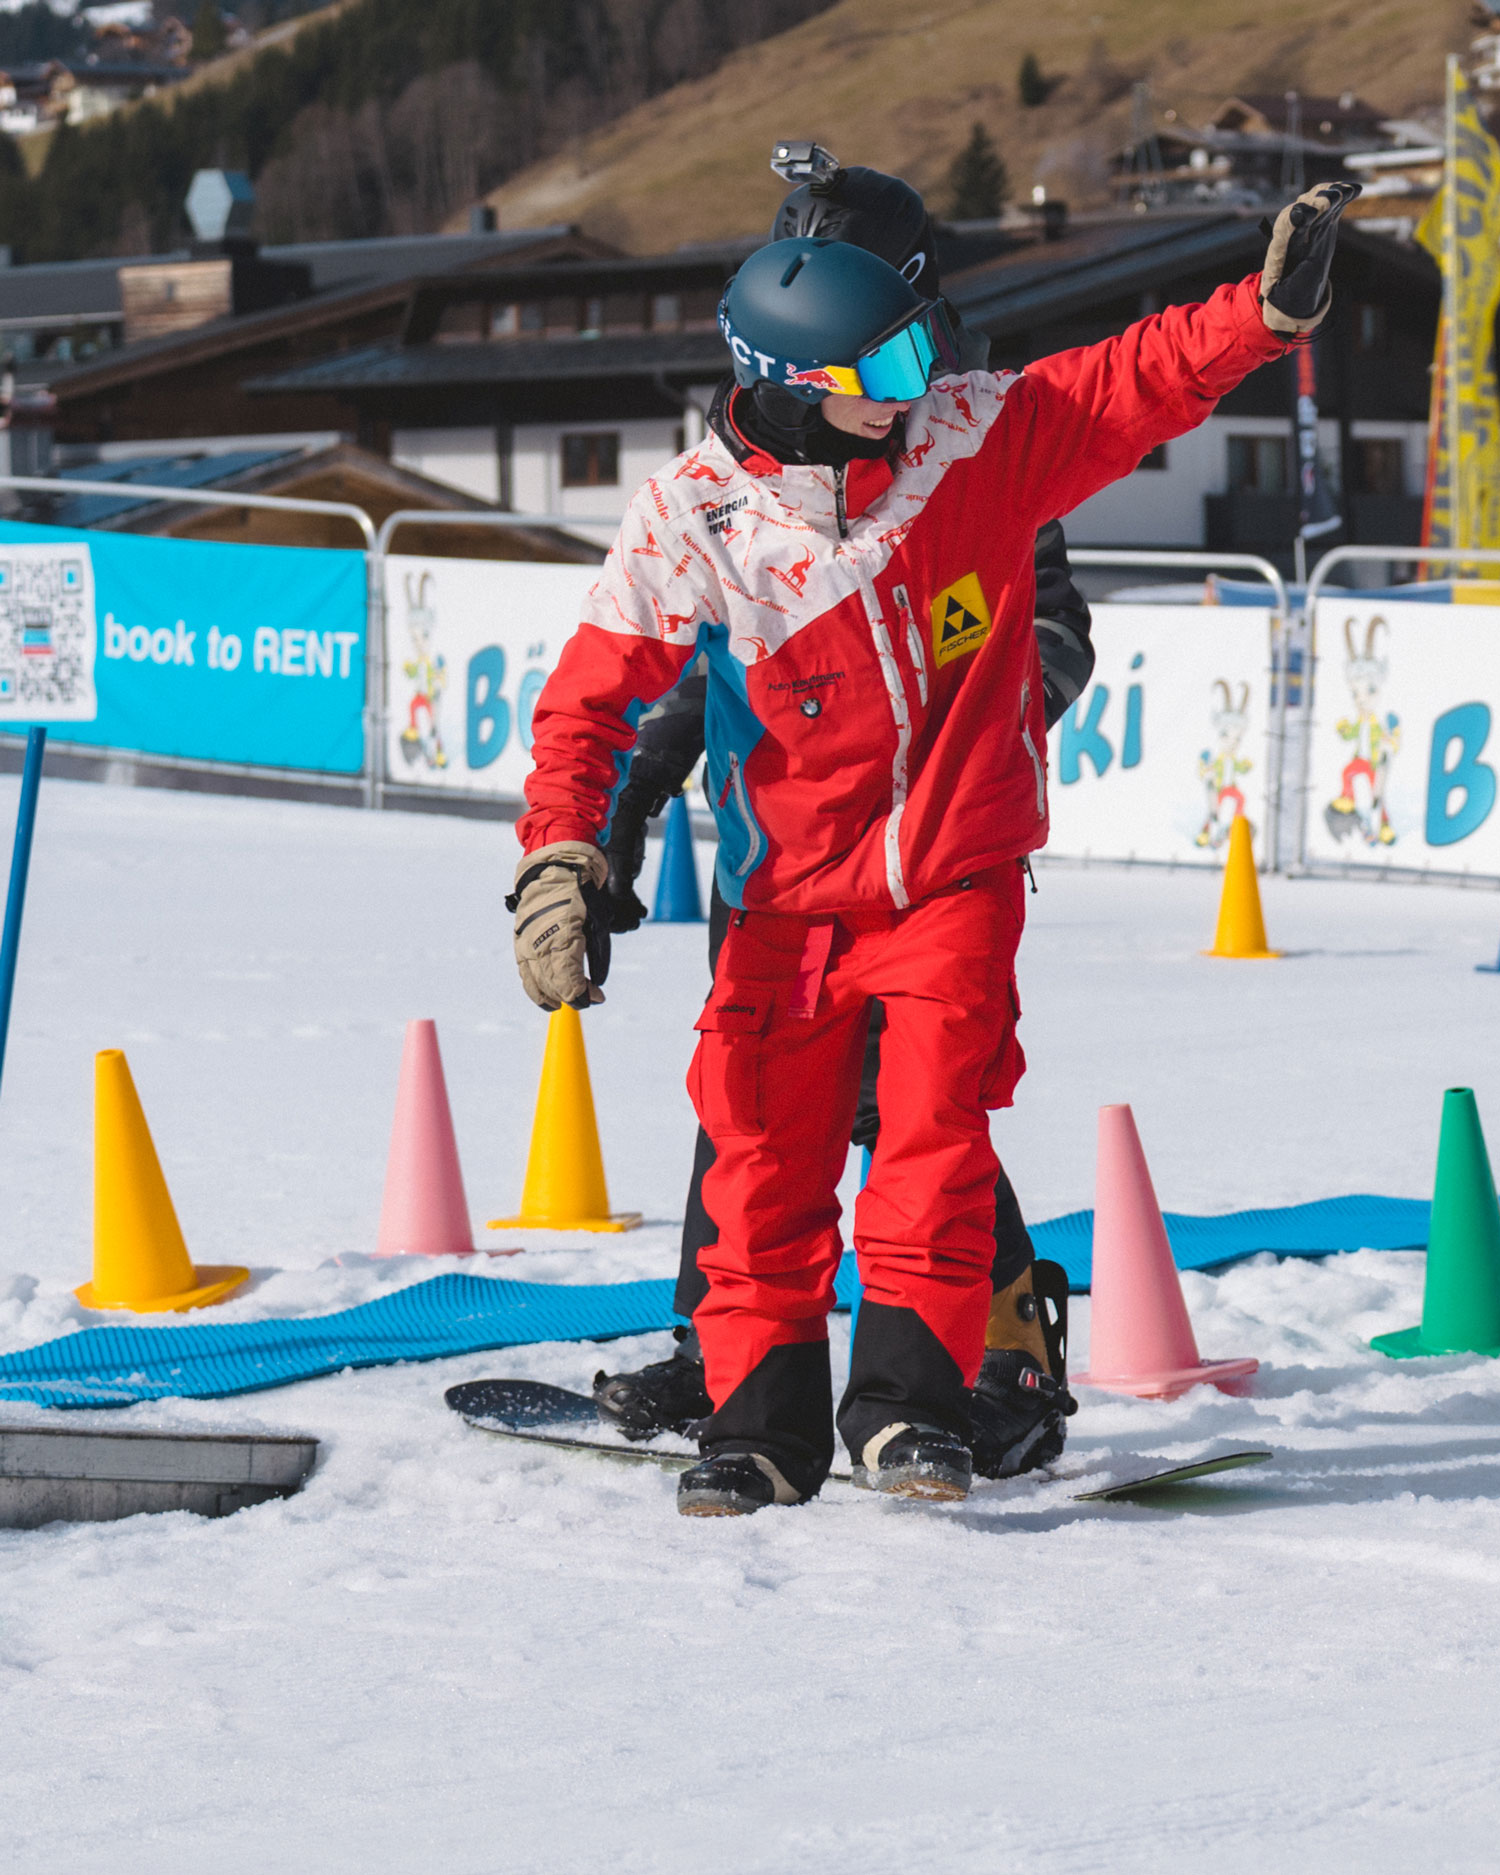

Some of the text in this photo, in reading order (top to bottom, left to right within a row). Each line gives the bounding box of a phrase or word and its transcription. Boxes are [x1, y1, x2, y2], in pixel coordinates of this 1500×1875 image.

[706, 495, 749, 523] ENERGIA
[104, 612, 197, 667] book
[207, 625, 243, 671] to
[253, 626, 359, 680] RENT
[939, 626, 988, 657] FISCHER
